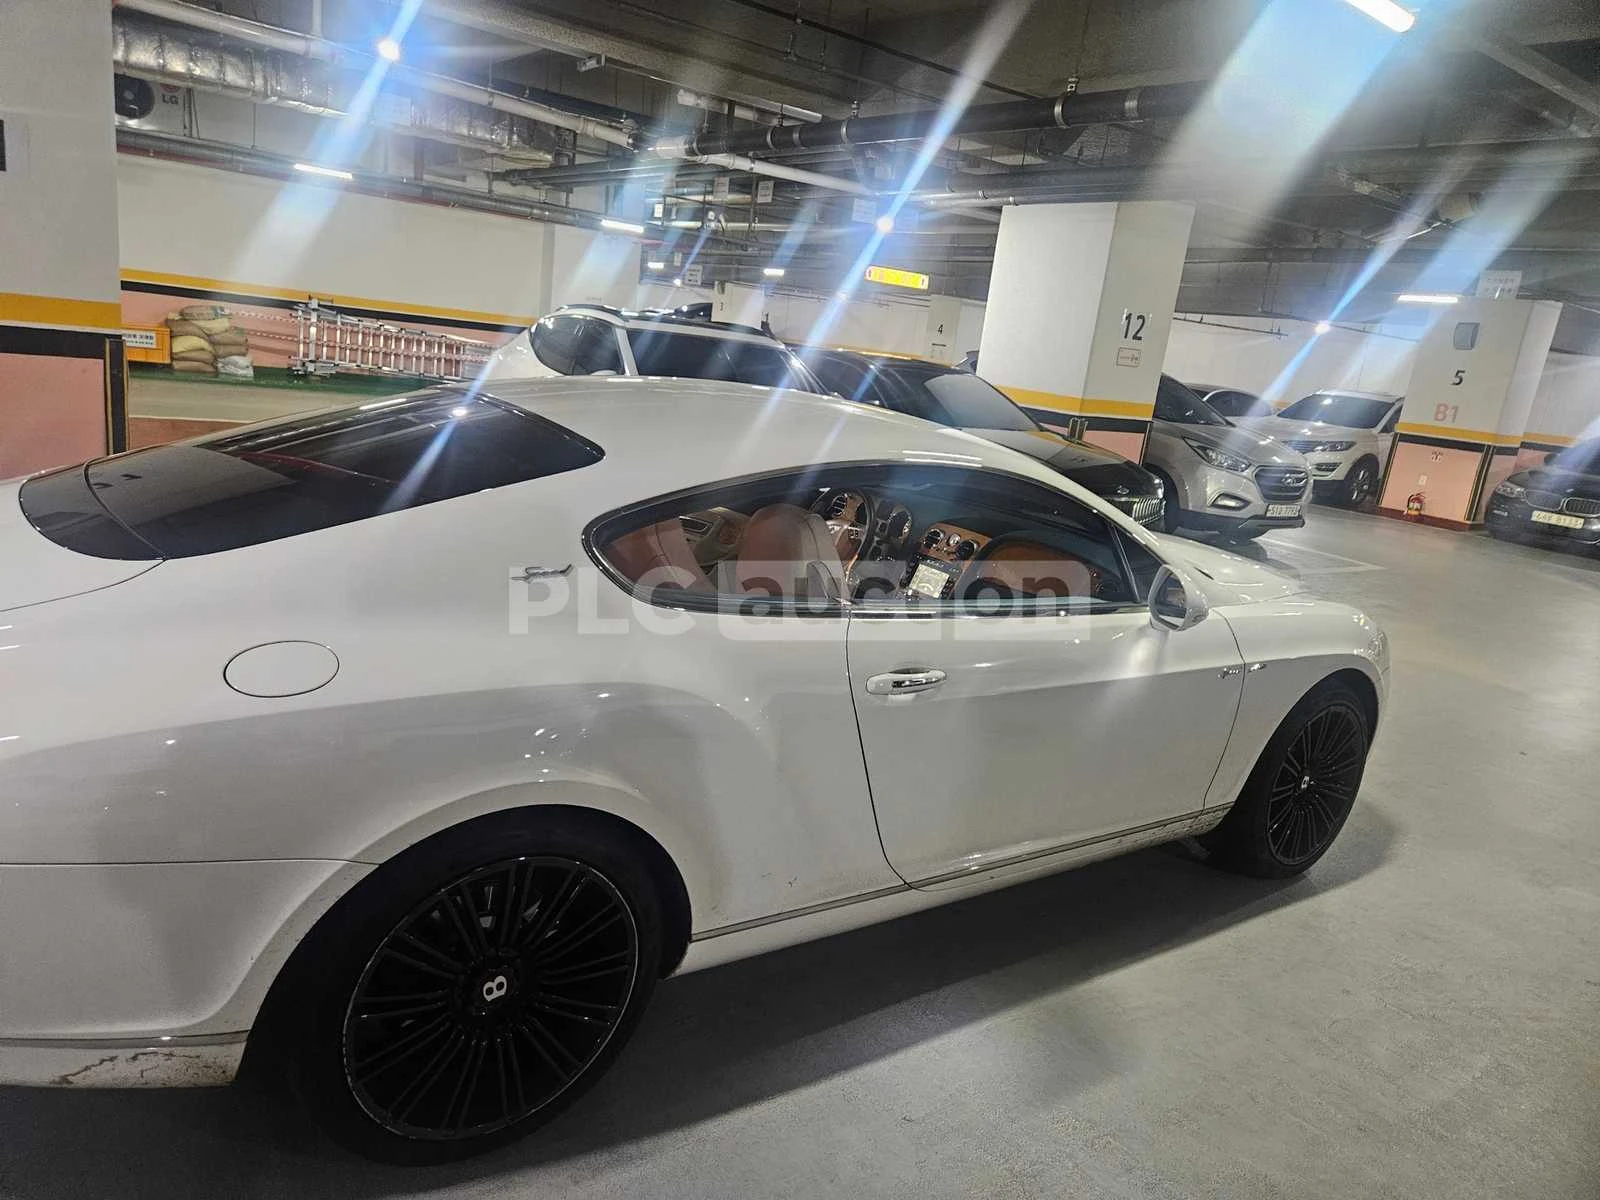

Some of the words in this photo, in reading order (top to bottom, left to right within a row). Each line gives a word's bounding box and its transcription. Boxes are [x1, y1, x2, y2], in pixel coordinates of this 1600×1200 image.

[161, 93, 179, 105] LG
[937, 324, 944, 335] 4
[1124, 312, 1145, 341] 12
[1451, 369, 1466, 386] 5
[1434, 403, 1459, 423] B1
[482, 975, 507, 1002] B
